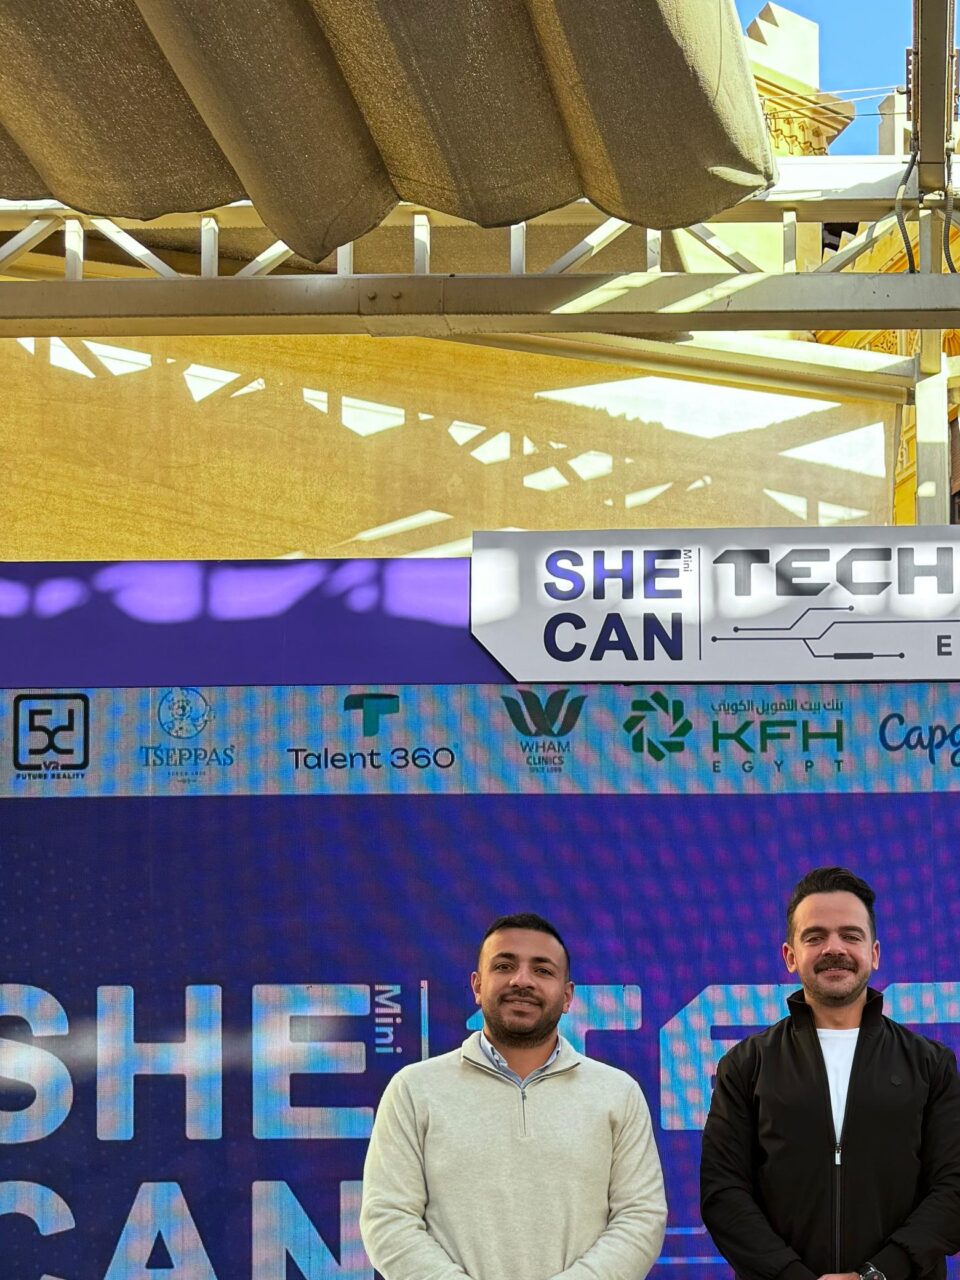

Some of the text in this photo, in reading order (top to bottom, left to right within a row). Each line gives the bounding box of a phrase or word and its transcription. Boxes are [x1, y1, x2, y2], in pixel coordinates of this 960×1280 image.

[544, 549, 683, 601] SHE
[683, 548, 692, 573] Mini
[712, 547, 953, 596] TECH
[543, 612, 683, 661] CAN
[520, 740, 571, 753] WHAM
[712, 719, 844, 753] KFH
[287, 747, 456, 770] Talent 360
[712, 759, 844, 774] EGYPT
[374, 984, 402, 1055] Mini
